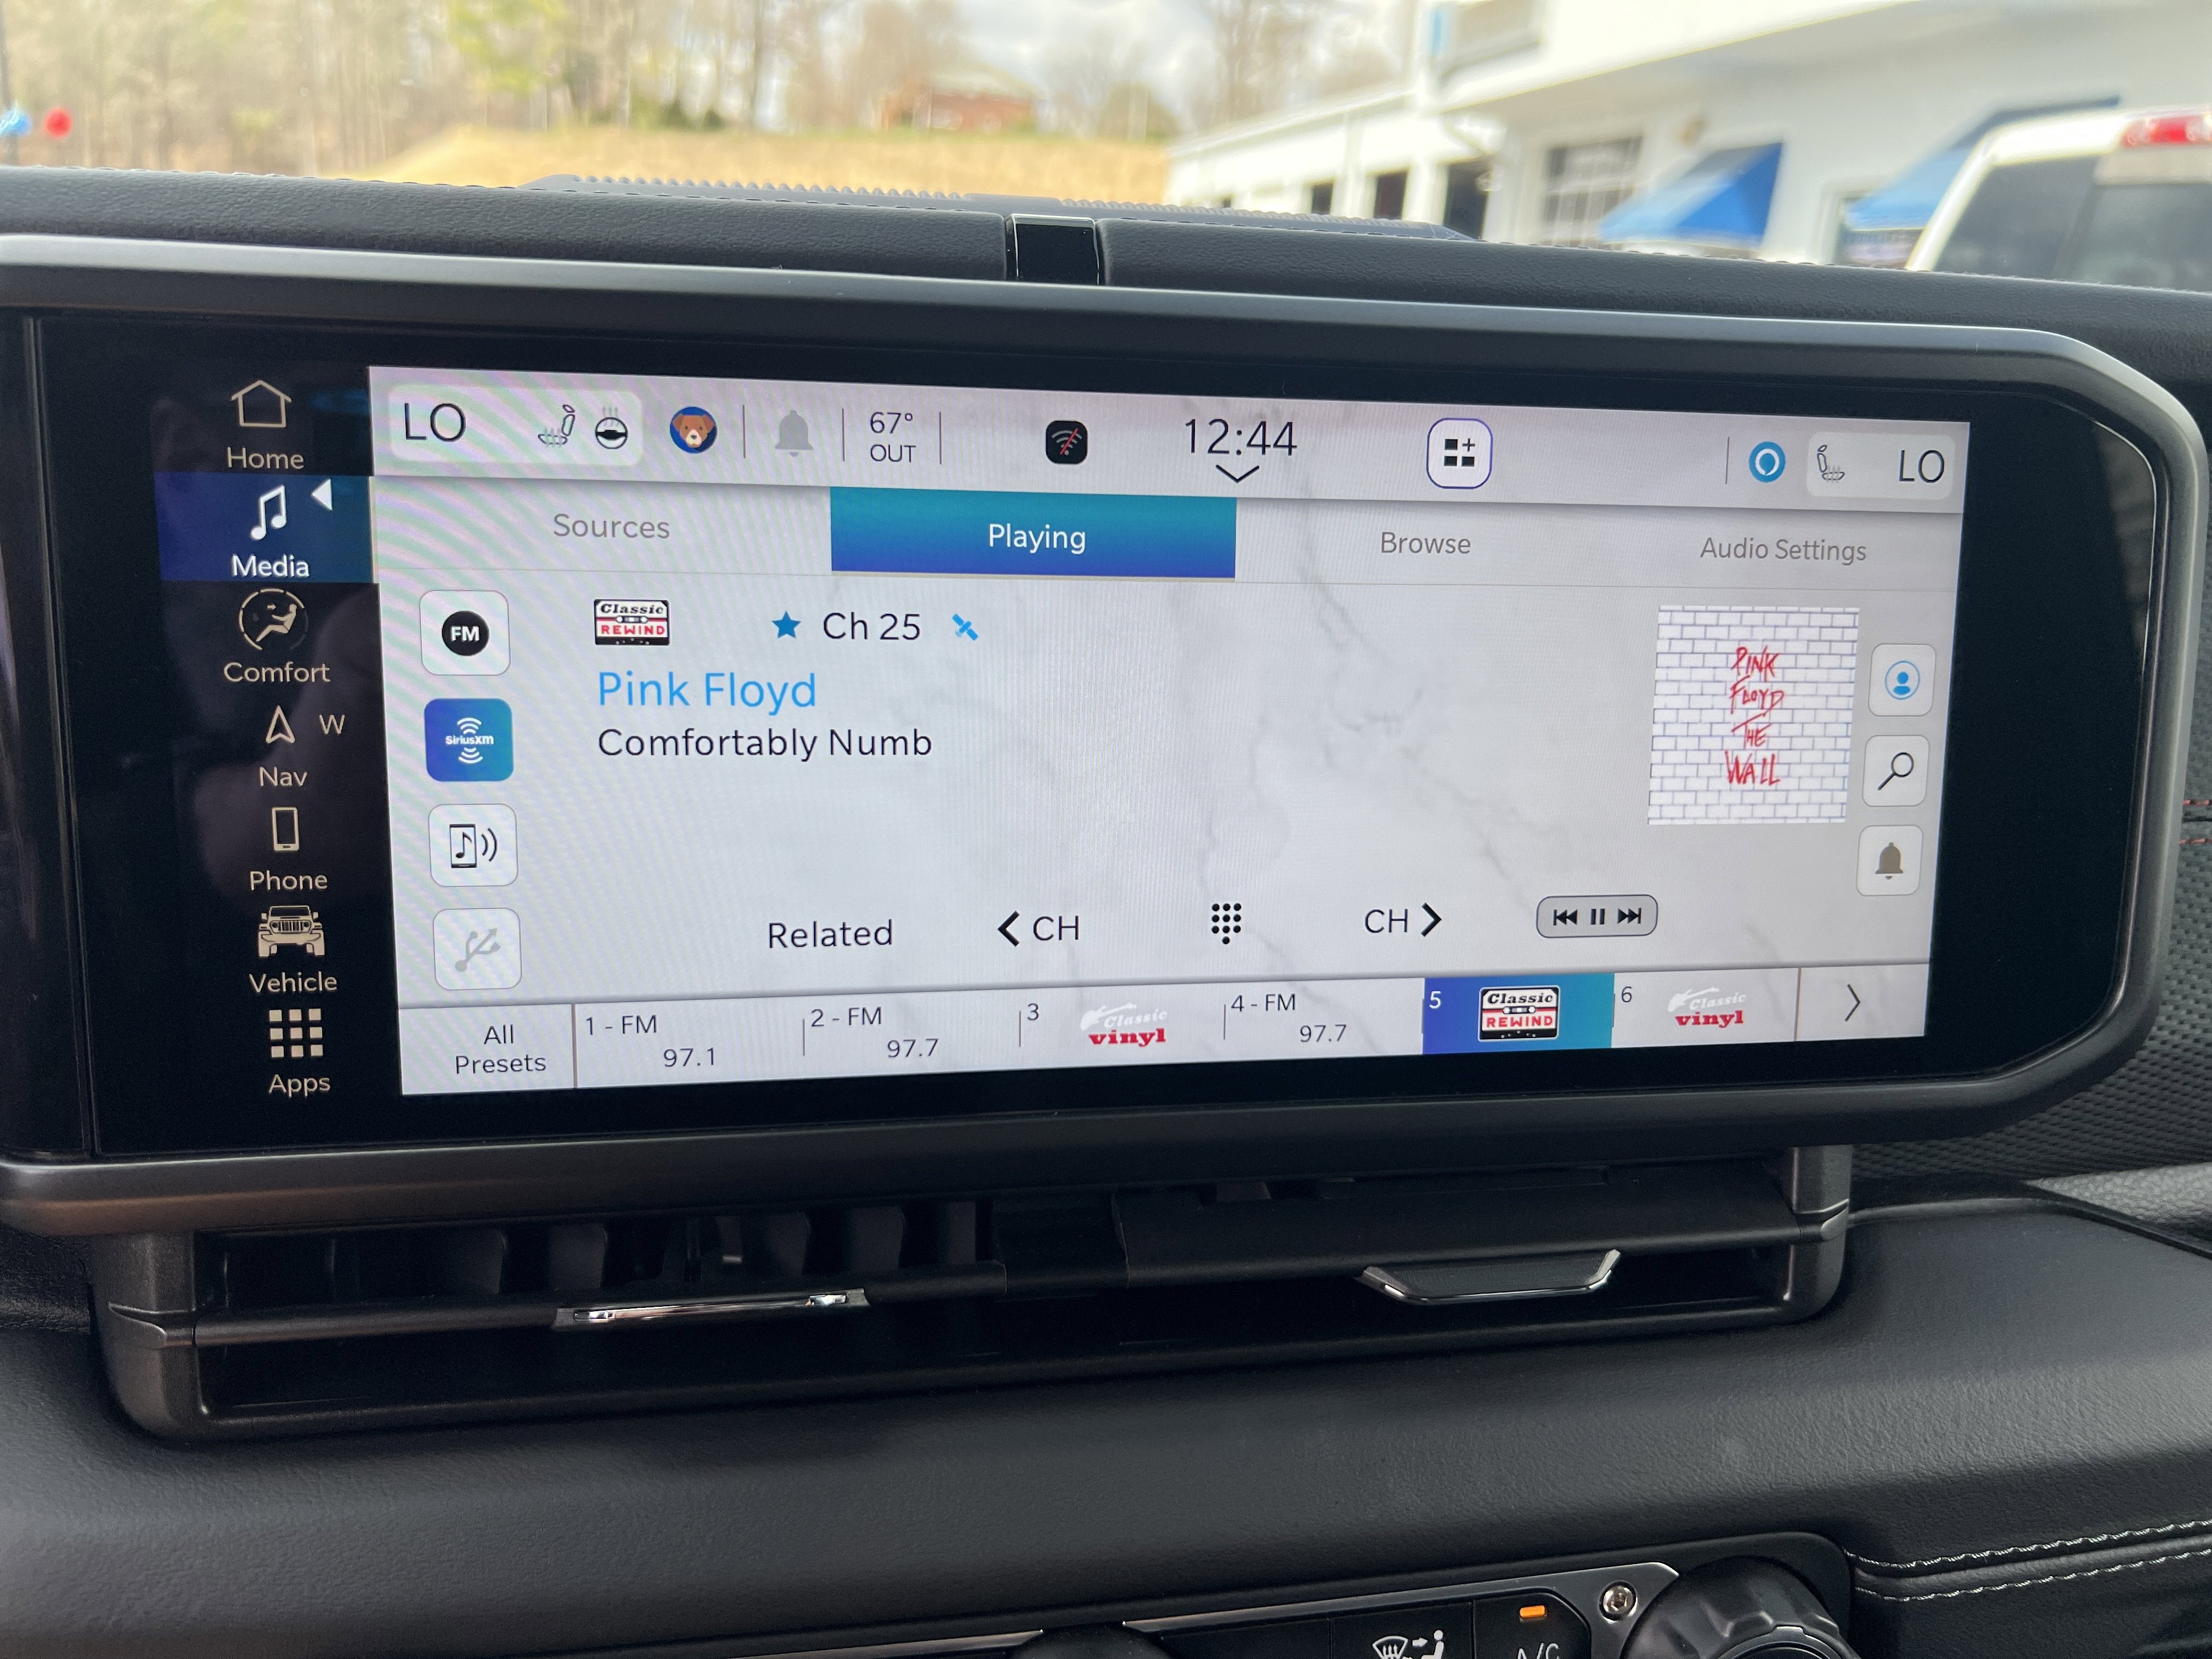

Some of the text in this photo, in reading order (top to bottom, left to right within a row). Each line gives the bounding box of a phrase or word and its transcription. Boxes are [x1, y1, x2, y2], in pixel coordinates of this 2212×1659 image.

[404, 402, 466, 442] LO
[1184, 418, 1298, 456] 12:44
[227, 447, 304, 470] Home
[869, 444, 917, 463] OUT
[1898, 449, 1945, 484] LO
[553, 513, 670, 540] Sources
[988, 522, 1087, 555] Playing
[1380, 531, 1471, 556] Browse
[1700, 537, 1867, 566] Audio Settings
[231, 554, 309, 578] Media
[600, 603, 664, 614] Classic
[450, 626, 481, 642] FM
[600, 624, 665, 636] REWIND
[823, 612, 921, 641] Ch 25
[223, 662, 331, 683] Comfort
[1730, 645, 1780, 683] PINK
[599, 670, 816, 716] Pink Floyd
[1729, 674, 1785, 716] FLOYD
[319, 714, 346, 736] W
[1731, 713, 1772, 749] THE
[599, 727, 932, 763] Comfortably Numb
[259, 766, 308, 787] Nav
[1724, 750, 1781, 786] WALL
[250, 870, 328, 892] Phone
[1032, 915, 1080, 941] CH
[1364, 907, 1409, 934] CH
[769, 919, 894, 949] Related
[250, 972, 338, 994] Vehicle
[1230, 994, 1245, 1013] 4
[1265, 993, 1296, 1012] FM
[1429, 990, 1442, 1009] 5
[1487, 992, 1554, 1006] Classic
[1621, 986, 1633, 1003] 6
[1688, 991, 1747, 1011] Classic
[810, 1008, 825, 1028] 2
[848, 1006, 883, 1026] FM
[1026, 1002, 1040, 1022] 3
[1103, 1008, 1169, 1029] Classic
[1486, 1014, 1554, 1029] REWIND
[1674, 1010, 1744, 1029] vinyl
[483, 1024, 515, 1046] All
[585, 1016, 595, 1036] 1
[621, 1014, 658, 1035] FM
[1299, 1024, 1347, 1043] 97.7
[1088, 1027, 1167, 1047] vinyl
[663, 1046, 716, 1068] 97.1
[887, 1038, 939, 1059] 97.7
[455, 1053, 547, 1075] Presets
[269, 1074, 331, 1097] Apps
